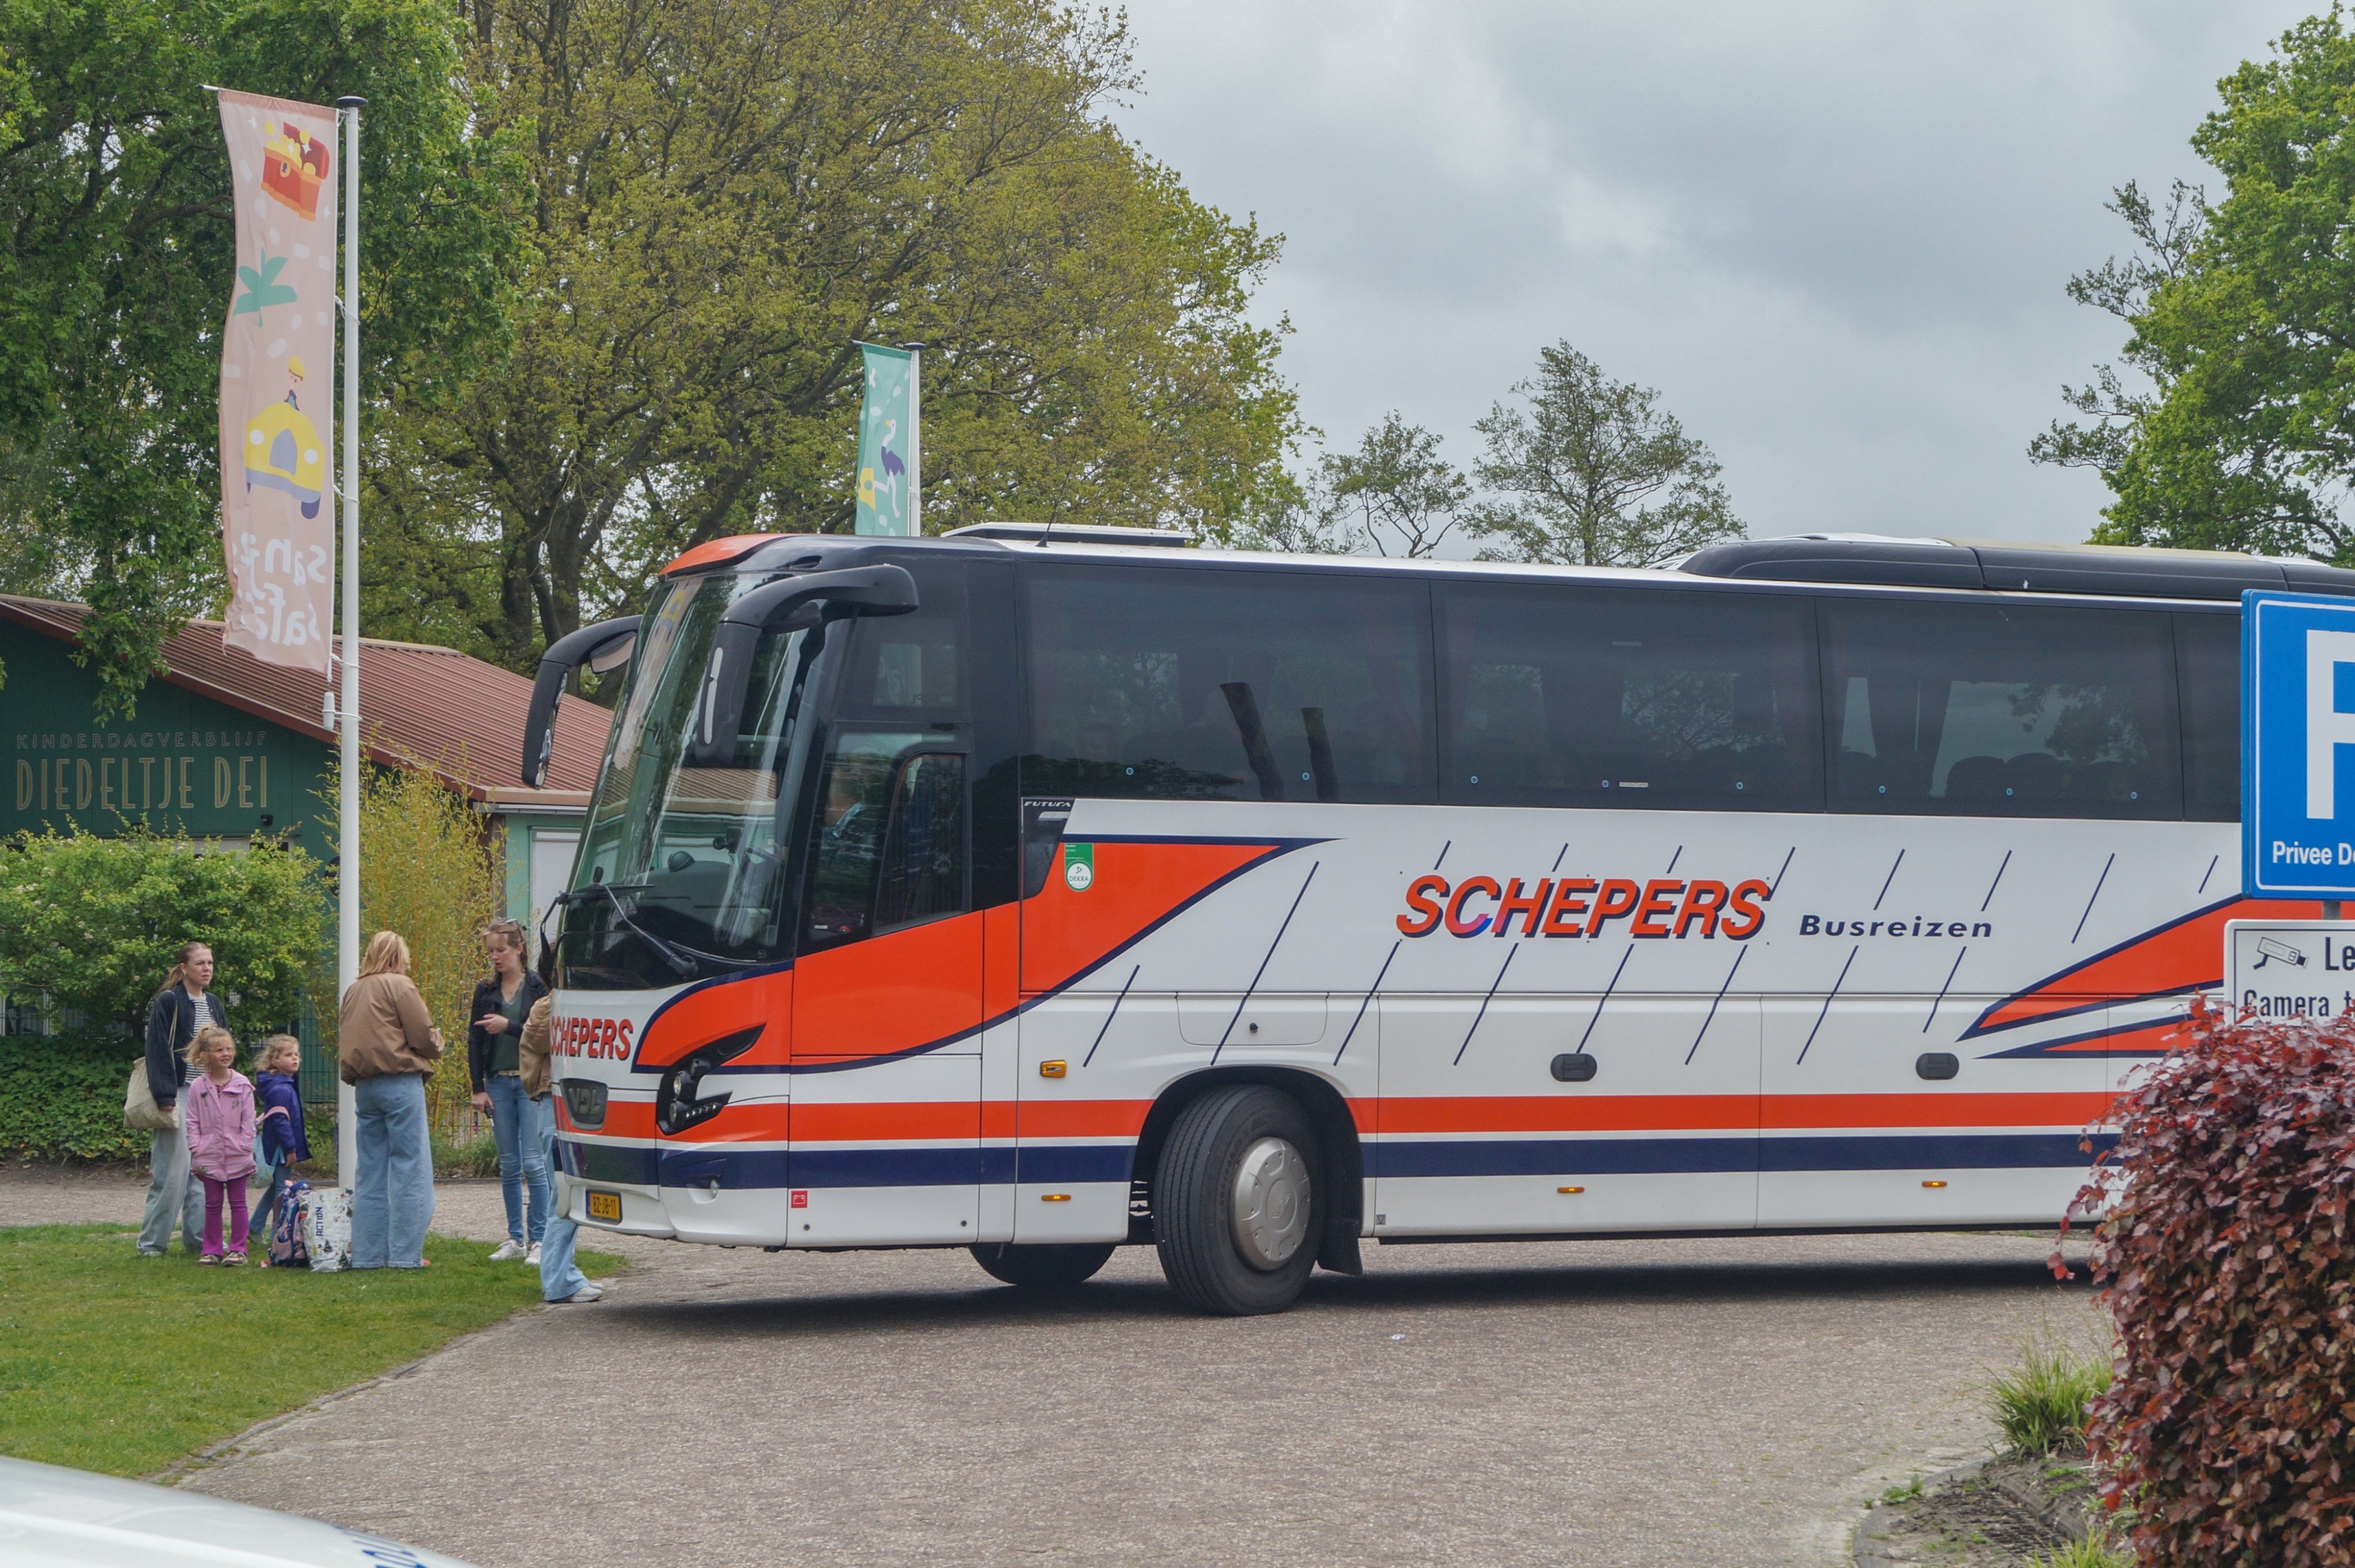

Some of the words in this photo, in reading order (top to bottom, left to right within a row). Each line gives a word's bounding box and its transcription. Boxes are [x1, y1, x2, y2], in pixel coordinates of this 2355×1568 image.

[17, 731, 267, 749] KINDERDAGVERBLIJF
[16, 757, 194, 810] DIEDELTJE
[214, 756, 267, 808] DEI
[2272, 840, 2332, 864] Privee
[2339, 842, 2355, 866] D
[1396, 874, 1770, 943] SCHEPERS
[1799, 913, 1994, 940] Busreizen
[2324, 936, 2355, 972] Le
[550, 1015, 633, 1060] SCHEPERS
[568, 1088, 602, 1115] VDL
[316, 1206, 324, 1237] ACTION
